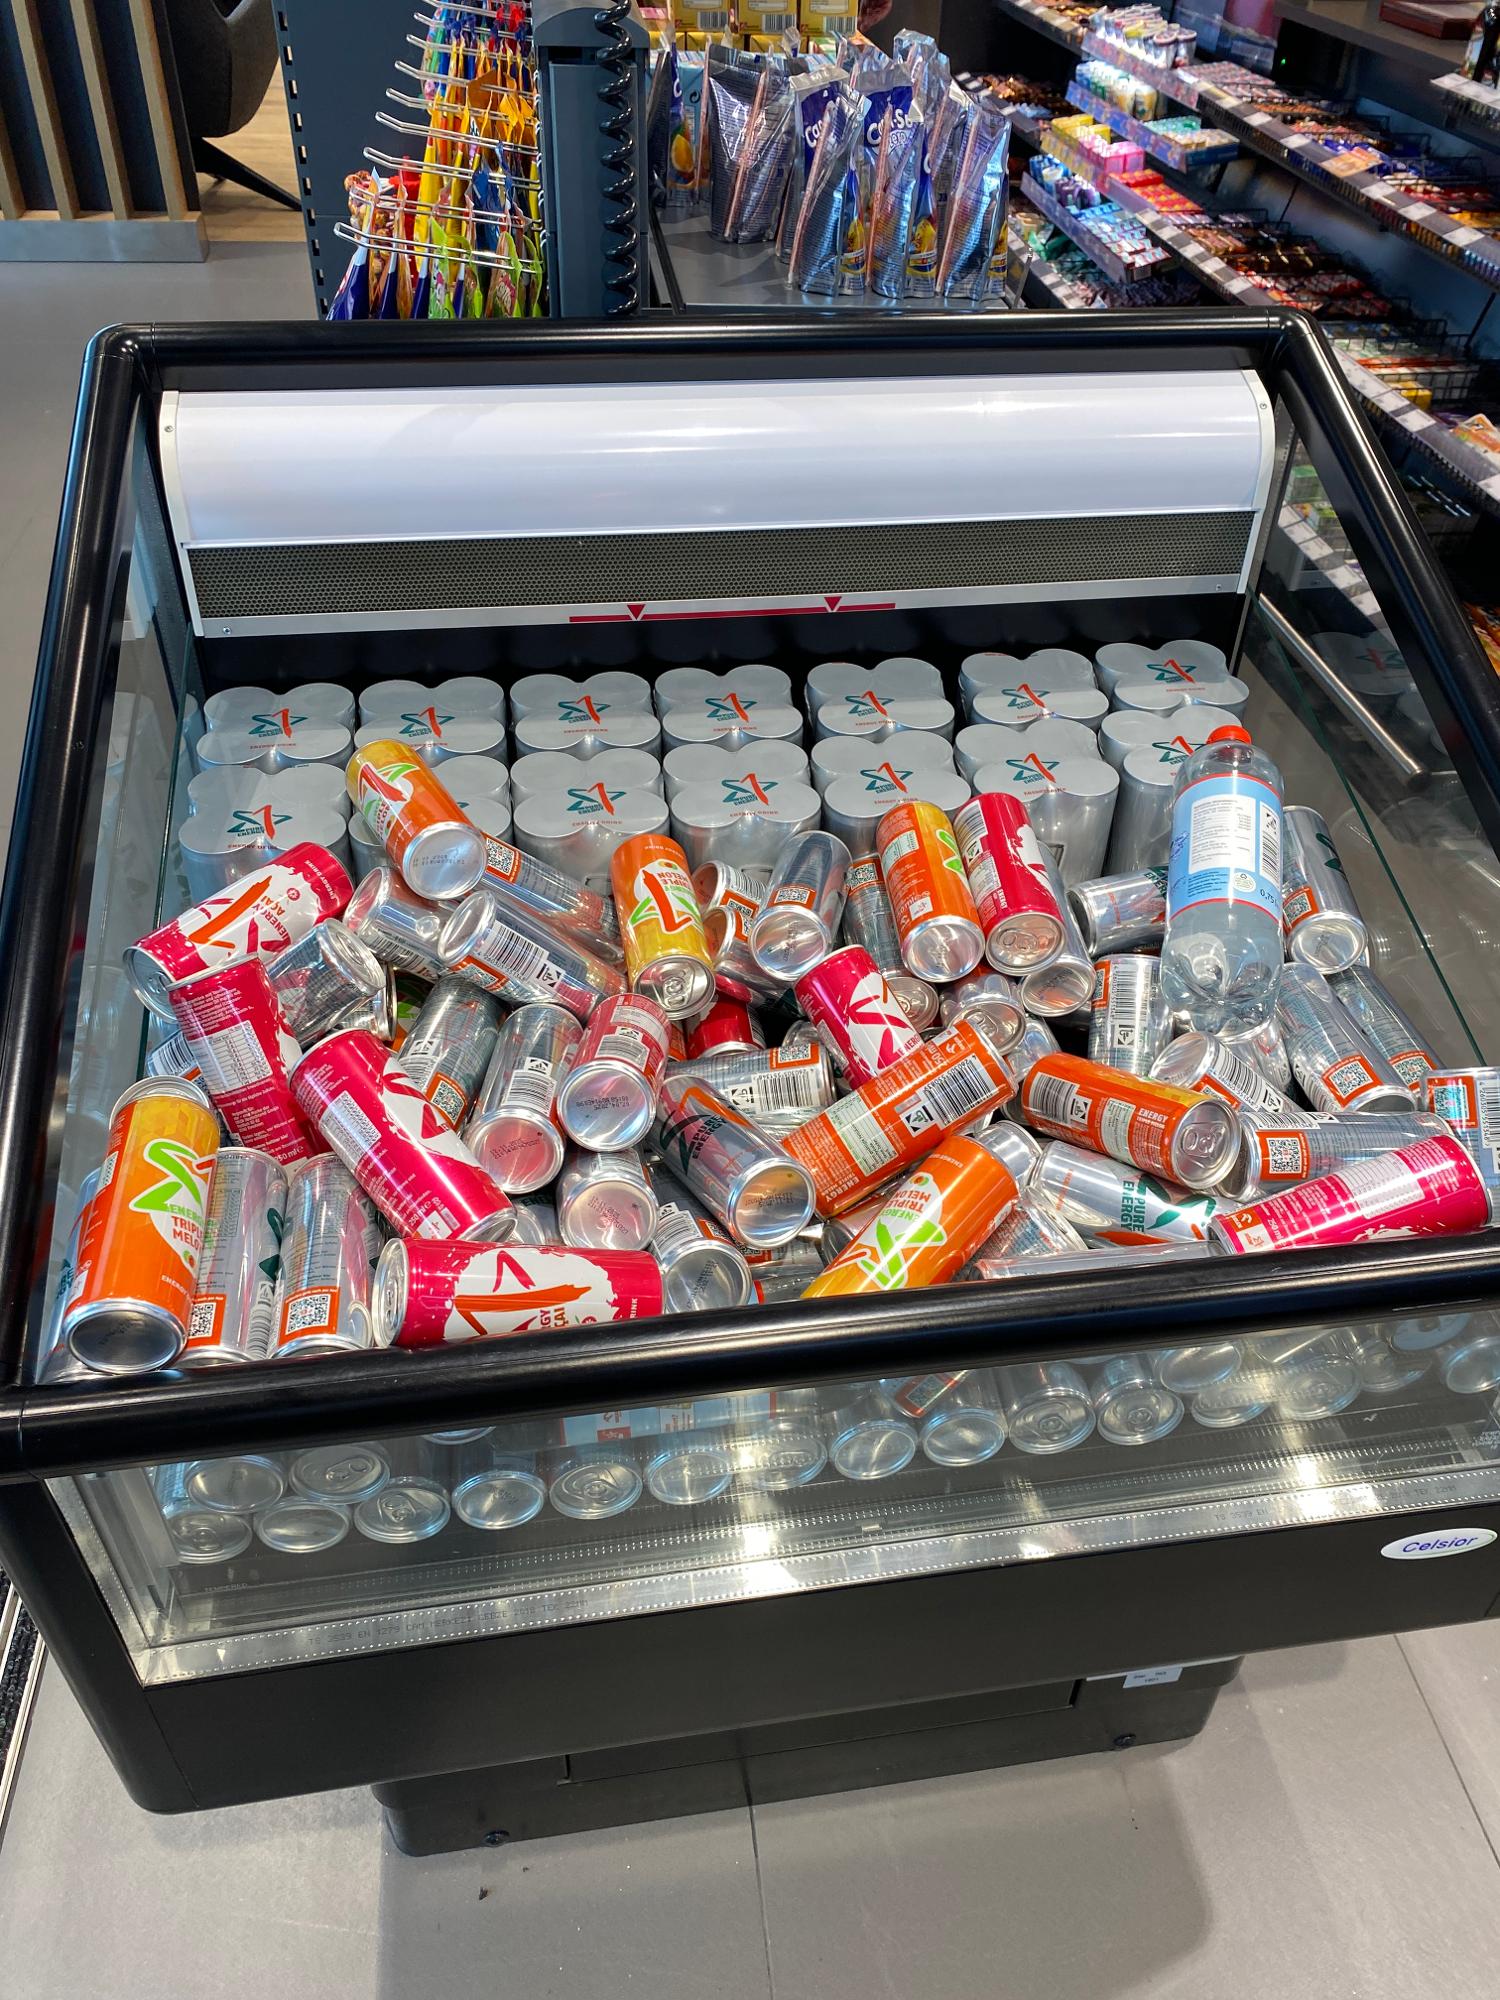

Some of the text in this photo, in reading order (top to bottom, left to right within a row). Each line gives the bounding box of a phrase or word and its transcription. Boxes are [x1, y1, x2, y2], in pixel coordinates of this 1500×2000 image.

[896, 1033, 921, 1056] ENERG
[694, 1113, 721, 1141] PURE
[1138, 1107, 1169, 1123] ENERGY
[691, 1116, 729, 1160] ENERGY
[825, 1176, 860, 1203] ENERGY
[895, 1190, 932, 1203] MELON
[172, 1203, 205, 1230] ENERG
[884, 1198, 924, 1213] TRIPLE
[1120, 1180, 1135, 1233] ENERGY
[1132, 1196, 1146, 1233] PURE
[1267, 1218, 1279, 1231] 250
[1402, 1536, 1479, 1553] Celsior
